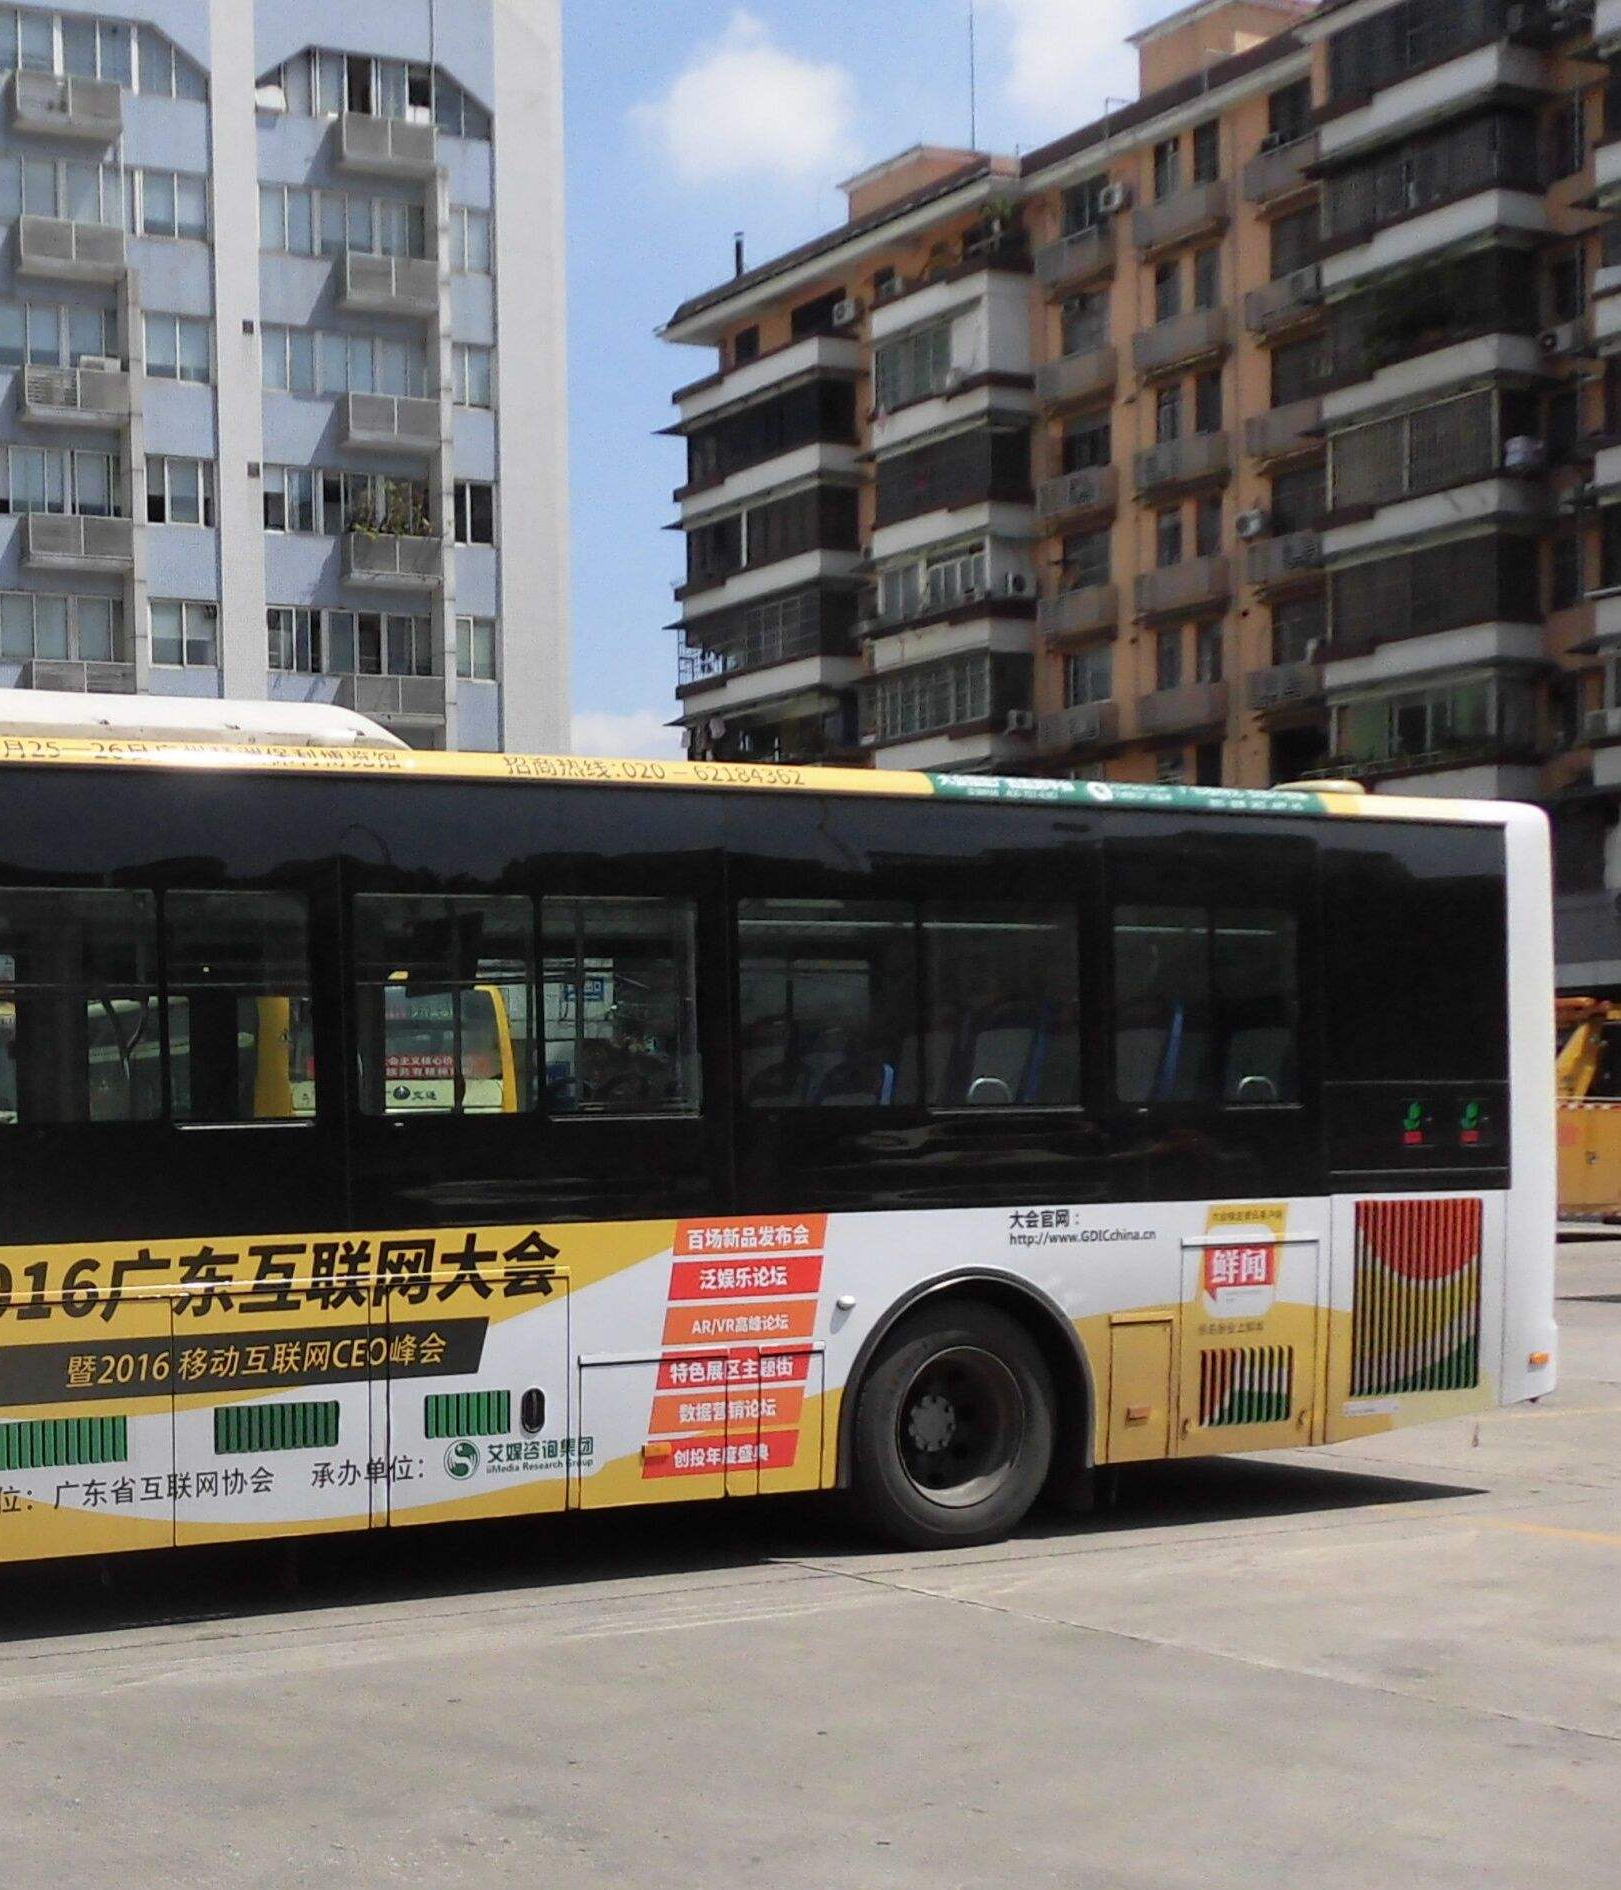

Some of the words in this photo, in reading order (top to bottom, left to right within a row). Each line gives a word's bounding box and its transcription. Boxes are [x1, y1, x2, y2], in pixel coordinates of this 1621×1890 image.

[687, 1224, 810, 1251] 百场新品发布会
[699, 1265, 788, 1291] 泛娱乐论坛
[1210, 1248, 1267, 1285] 鲜闻
[691, 1313, 790, 1336] AR/VR高峰论坛
[669, 1356, 795, 1384] 特色展区主题街
[678, 1398, 777, 1424] 数据营销论坛
[487, 1436, 594, 1464] 艾媒咨询集团
[673, 1443, 770, 1469] 创投年度盛典
[522, 1459, 563, 1472] Research
